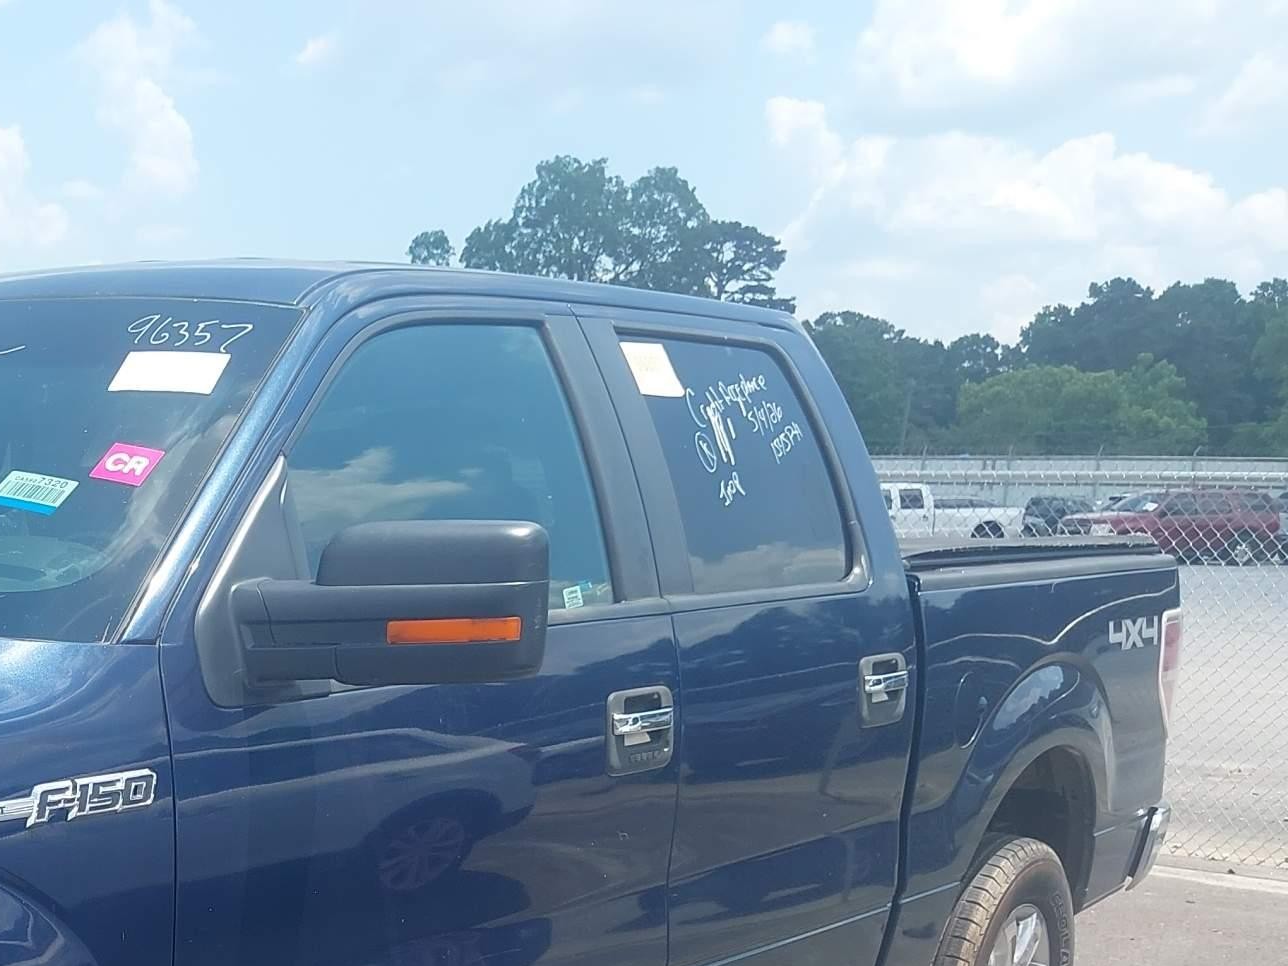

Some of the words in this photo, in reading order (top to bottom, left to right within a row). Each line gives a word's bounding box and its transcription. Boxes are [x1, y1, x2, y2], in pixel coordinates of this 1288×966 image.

[127, 314, 254, 353] 96357
[105, 452, 150, 476] CR
[25, 768, 157, 829] F-150
